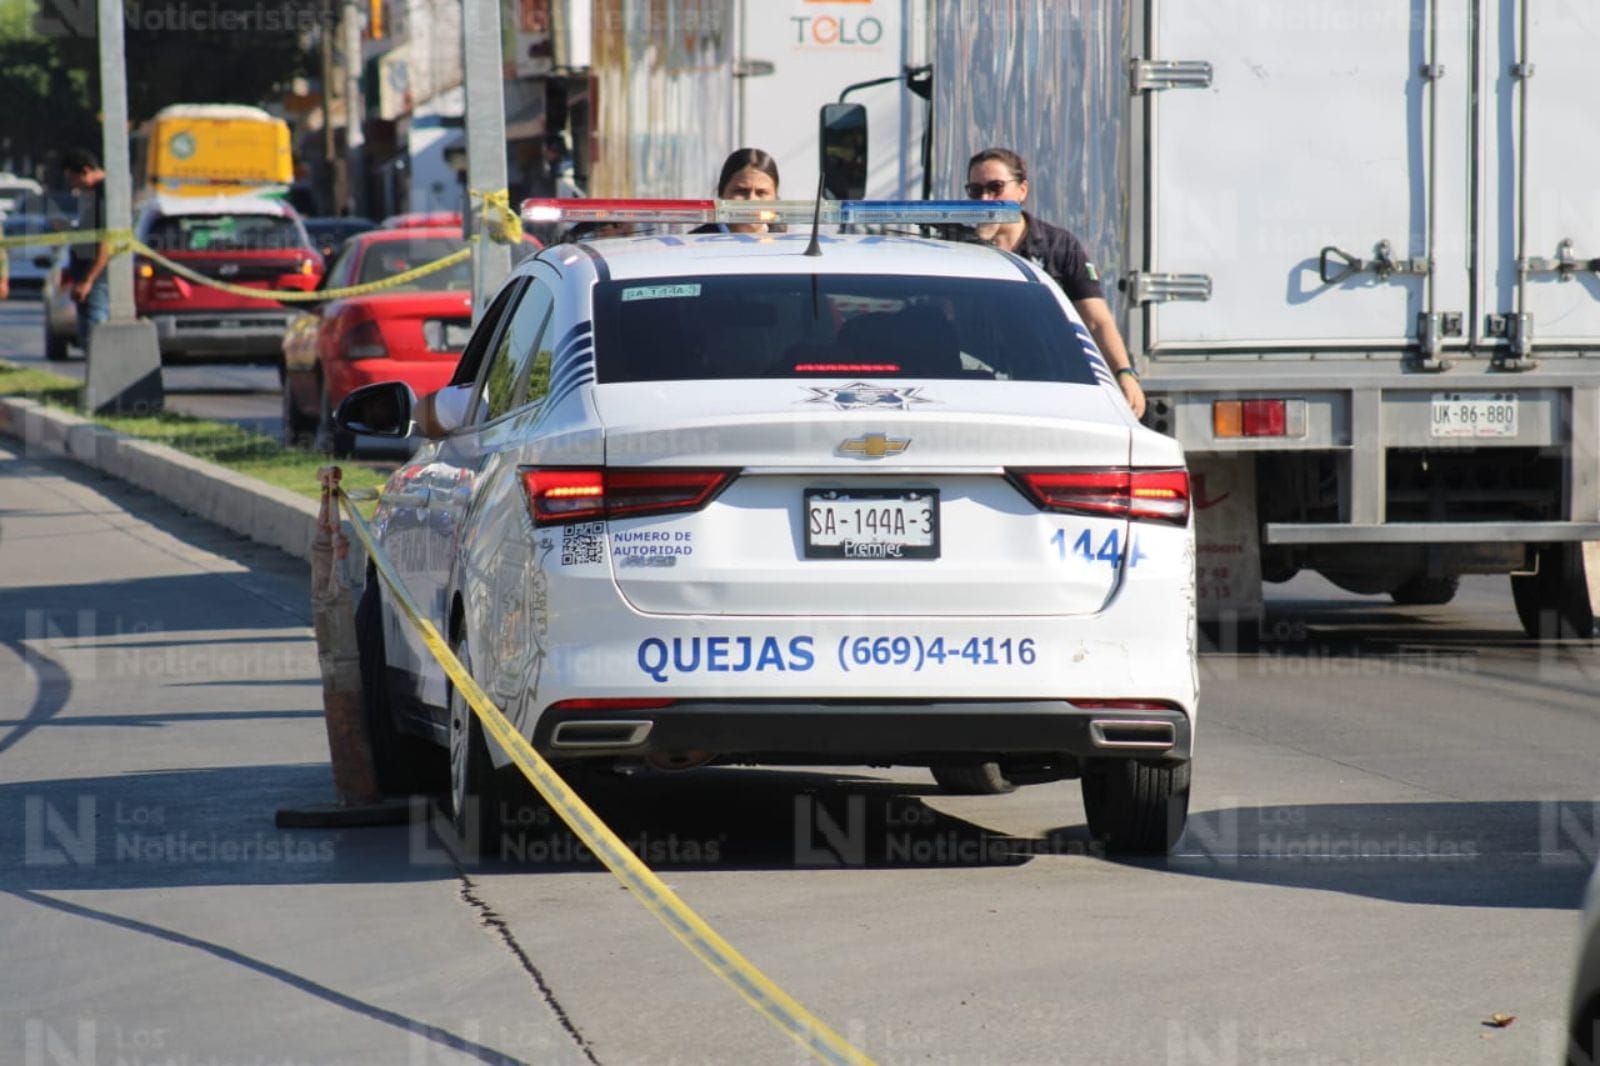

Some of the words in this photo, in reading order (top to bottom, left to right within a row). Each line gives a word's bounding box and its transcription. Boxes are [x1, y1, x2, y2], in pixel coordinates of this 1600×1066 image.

[1433, 404, 1514, 424] UK-86-880
[810, 507, 933, 536] SA-144A-3
[674, 531, 692, 541] DE
[613, 545, 693, 556] AUTORIDAD
[844, 540, 904, 557] Premier
[636, 635, 815, 683] QUEJAS
[838, 635, 1037, 673] (669)4-4116
